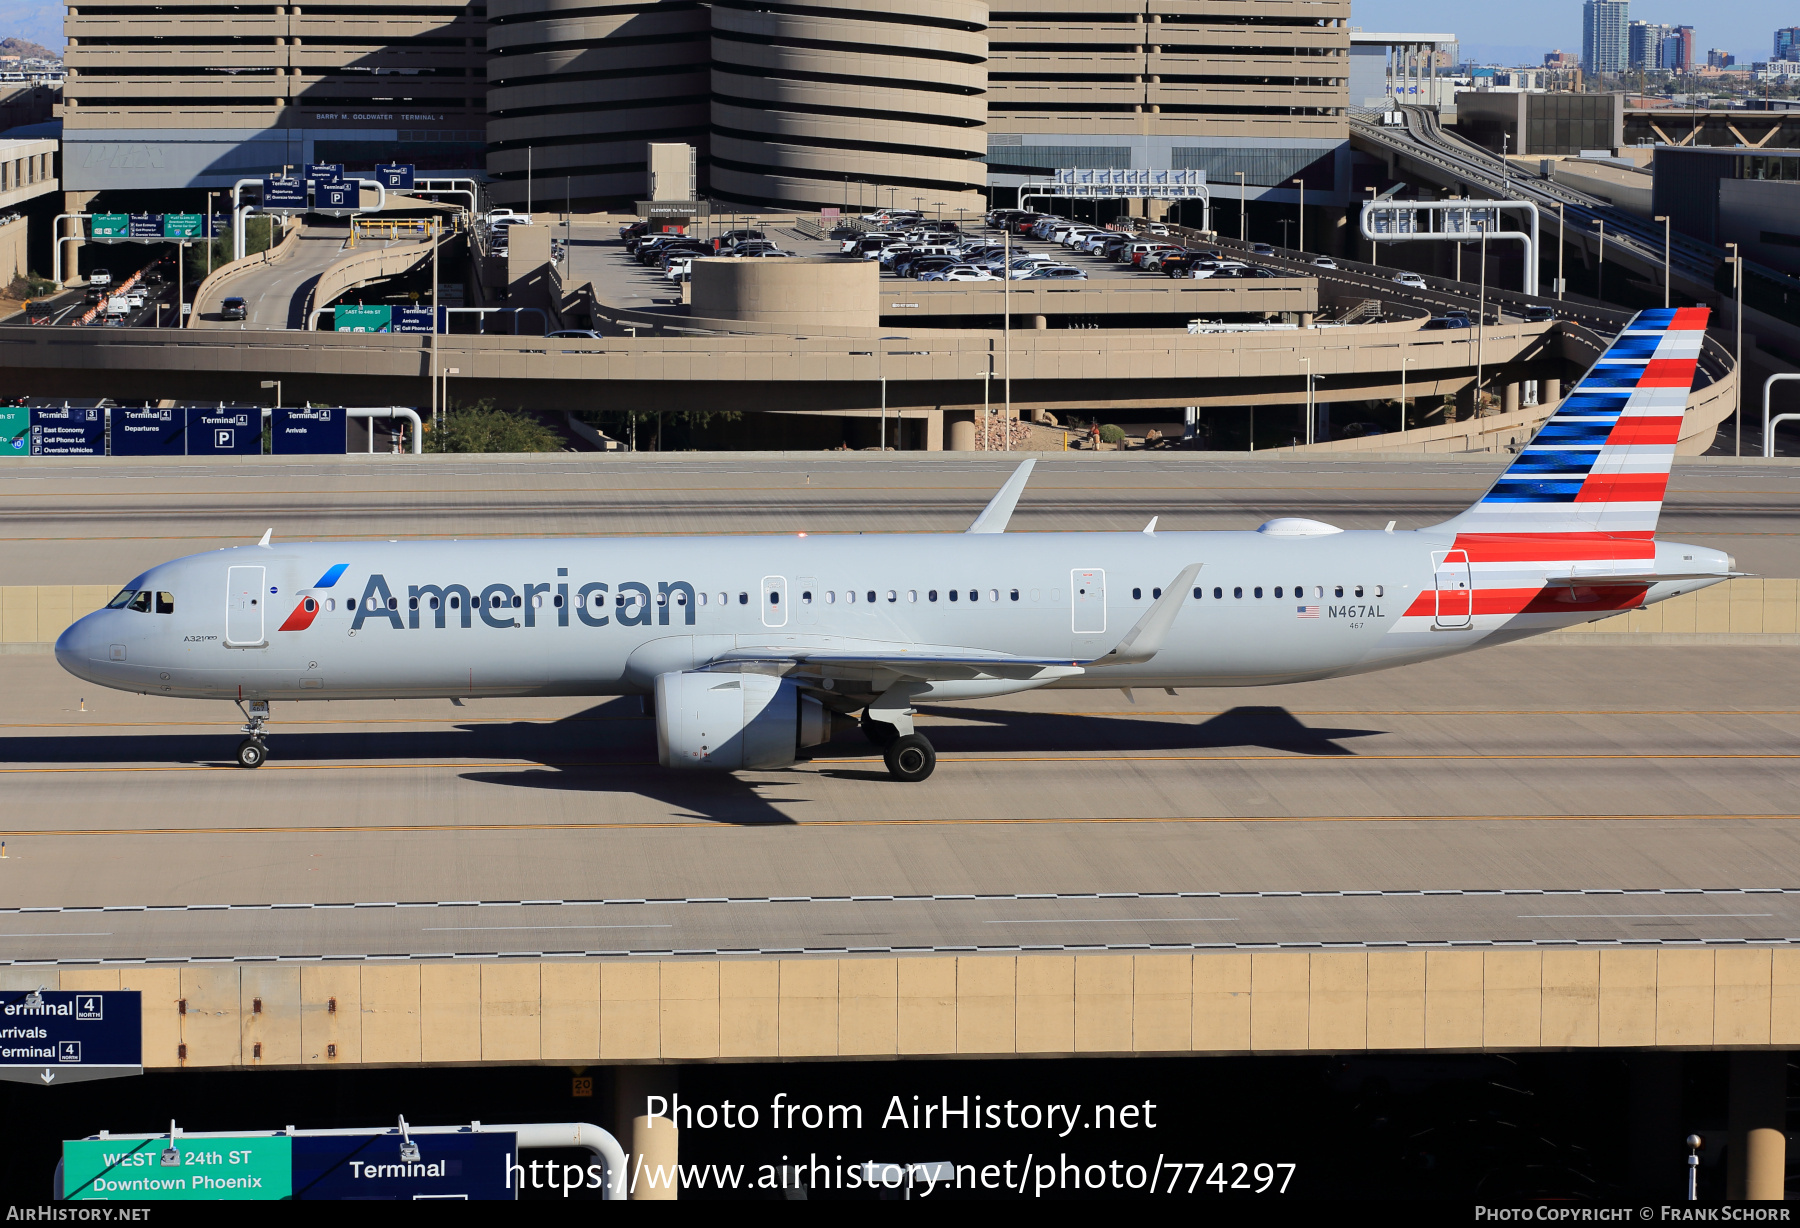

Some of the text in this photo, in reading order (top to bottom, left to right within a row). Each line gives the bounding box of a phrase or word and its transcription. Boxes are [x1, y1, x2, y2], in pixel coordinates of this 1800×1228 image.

[334, 194, 340, 202] P
[219, 432, 230, 445] P
[352, 568, 696, 630] American
[1328, 606, 1385, 618] N467AL
[84, 998, 94, 1011] 4
[0, 1026, 47, 1038] rrivals
[0, 1044, 74, 1057] erminal 4
[575, 1080, 590, 1088] 20
[103, 1150, 252, 1167] WEST 24th ST
[349, 1160, 445, 1178] Terminal
[93, 1175, 262, 1192] Downtown Phoenix
